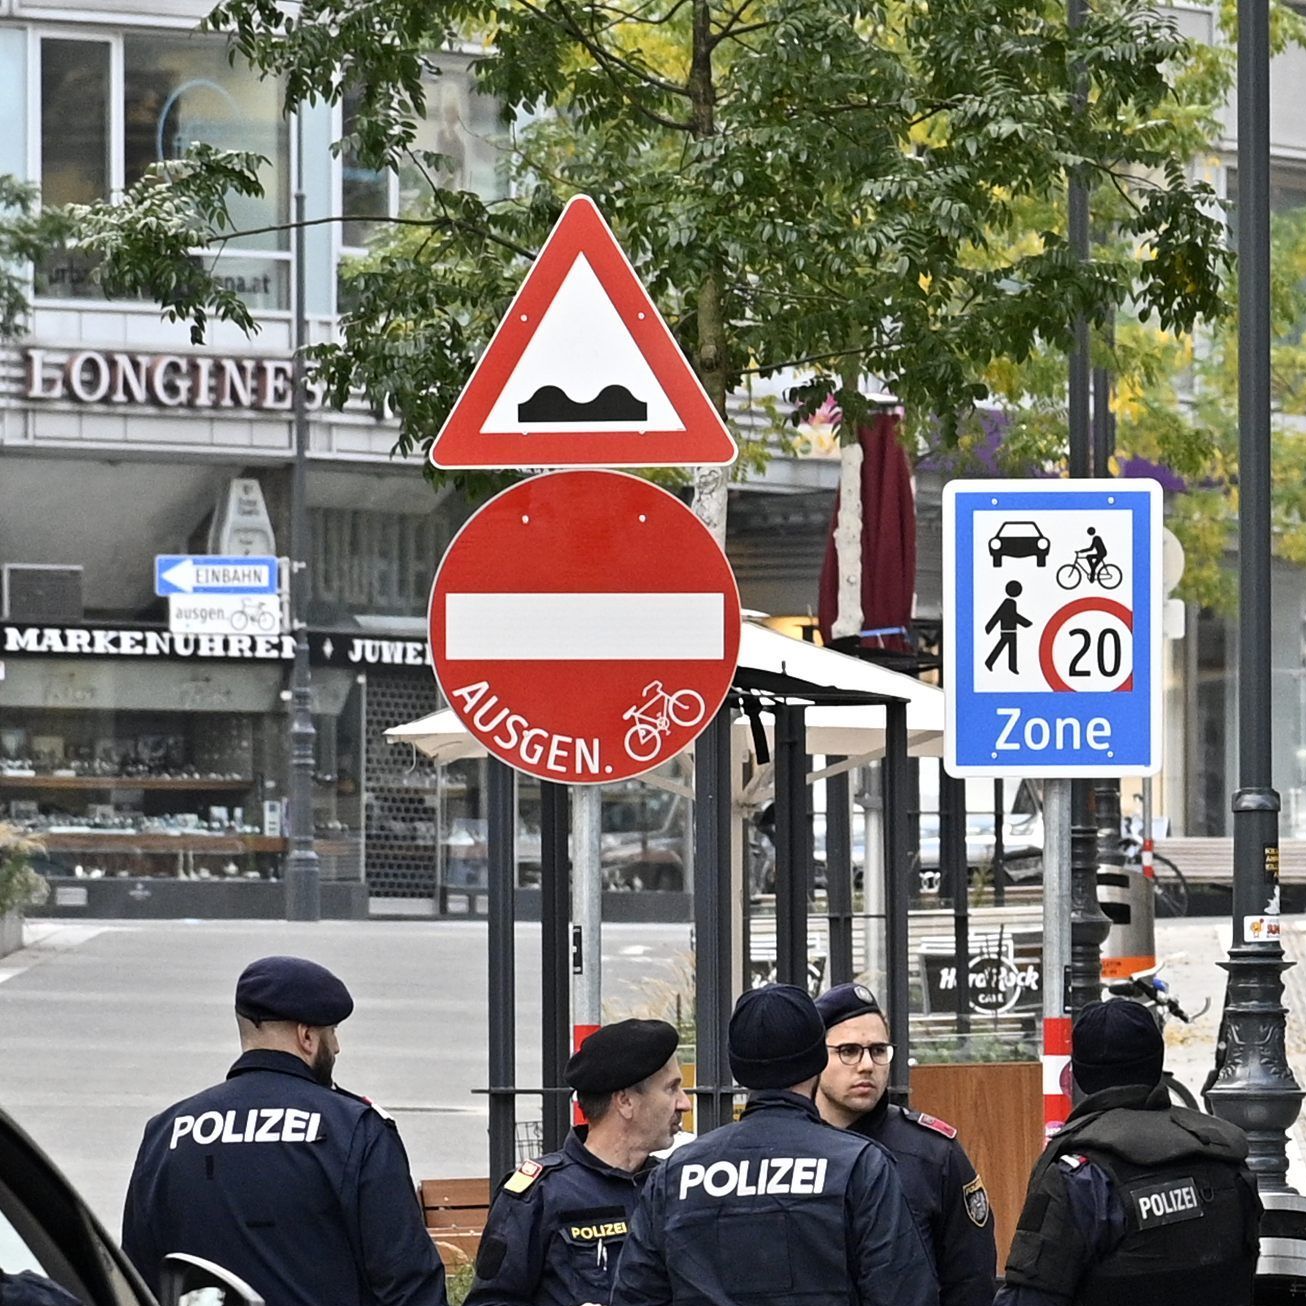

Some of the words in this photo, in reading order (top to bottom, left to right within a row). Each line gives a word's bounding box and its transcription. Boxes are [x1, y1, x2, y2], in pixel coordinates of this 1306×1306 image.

[195, 568, 263, 584] EINBAHN
[1068, 628, 1122, 678] 20
[452, 681, 613, 774] AUSGEN.
[995, 707, 1113, 751] Zone
[169, 1108, 322, 1150] POLIZEI
[679, 1157, 829, 1200] POLIZEI
[1139, 1186, 1198, 1220] POLIZEI
[571, 1221, 628, 1240] POLIZEI
